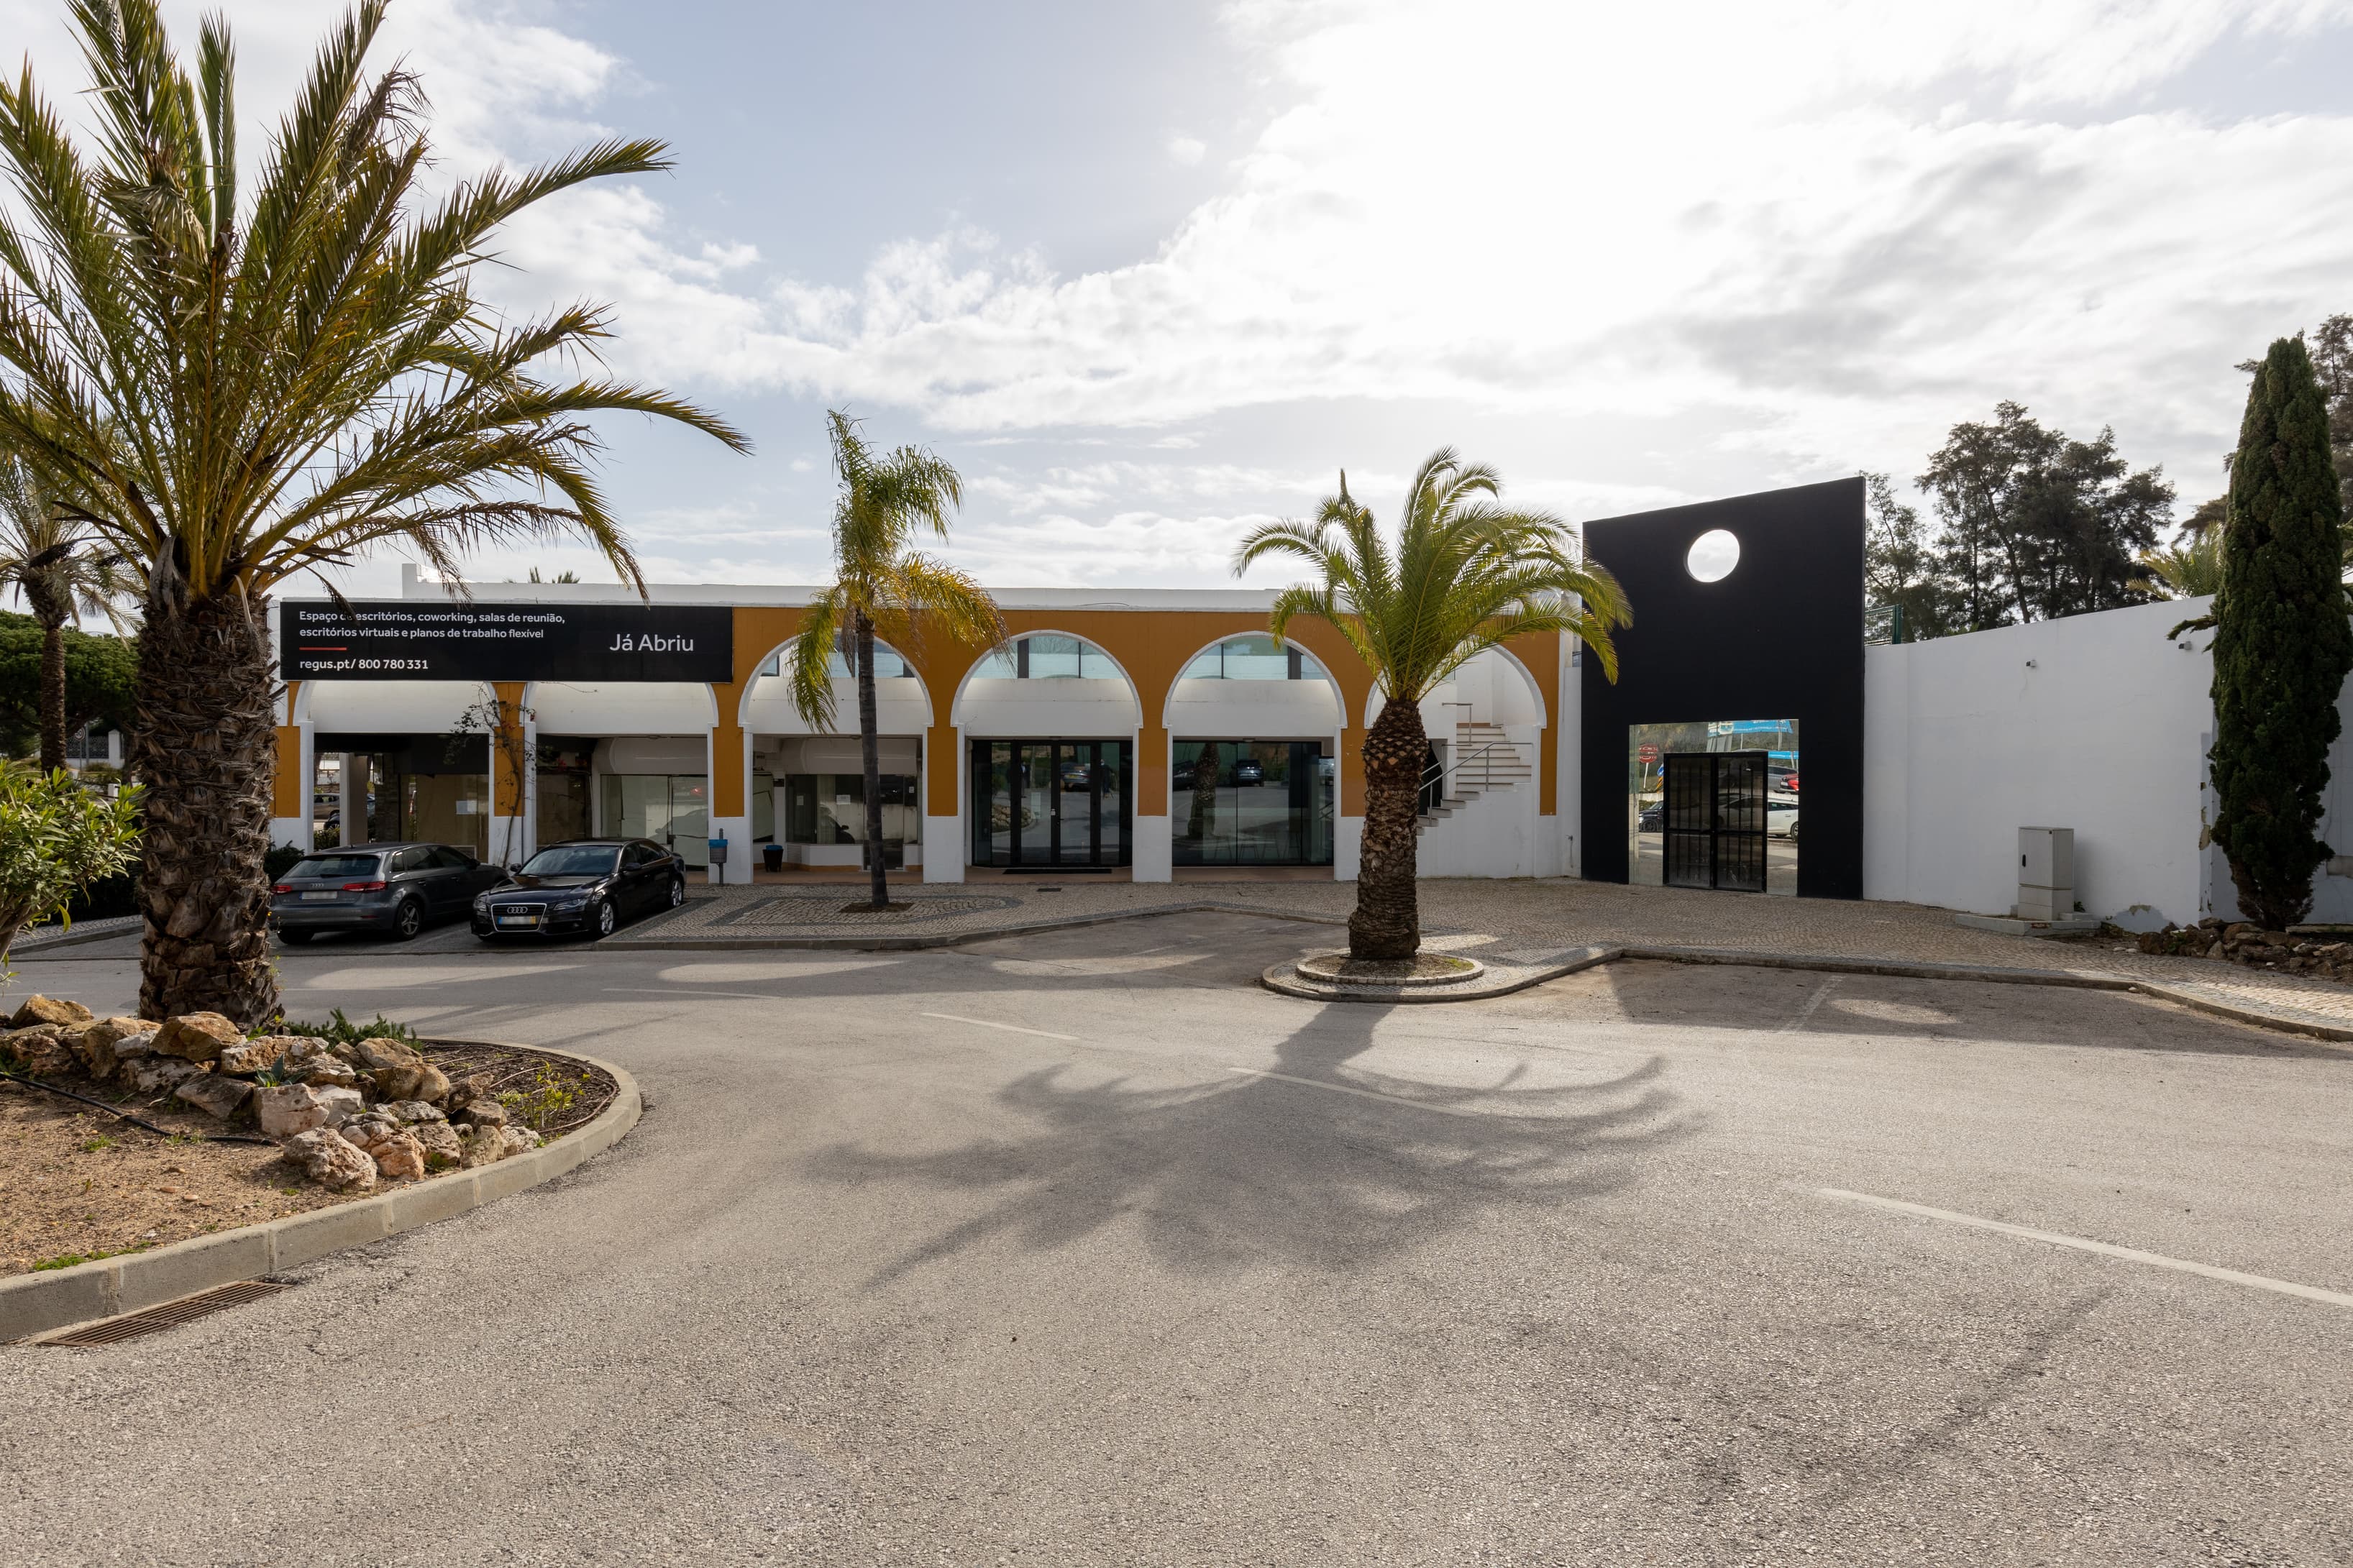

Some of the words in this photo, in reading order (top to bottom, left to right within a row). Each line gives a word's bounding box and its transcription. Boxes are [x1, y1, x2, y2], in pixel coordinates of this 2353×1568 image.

[299, 610, 338, 623] Espaço
[355, 610, 416, 623] escritórios,
[417, 612, 476, 624] coworking,
[478, 613, 506, 623] salas
[507, 613, 521, 623] de
[522, 613, 565, 624] reunião,
[299, 627, 357, 638] escritórios
[359, 627, 400, 638] virtuais
[410, 628, 446, 640] planos
[447, 628, 461, 638] de
[462, 628, 507, 638] trabalho
[508, 629, 544, 638] flexível
[609, 634, 633, 651] Já
[637, 634, 694, 652] Abriu
[299, 658, 357, 671] regus.pt/
[358, 659, 381, 669] 800
[383, 659, 406, 669] 780
[406, 659, 429, 670] 331
